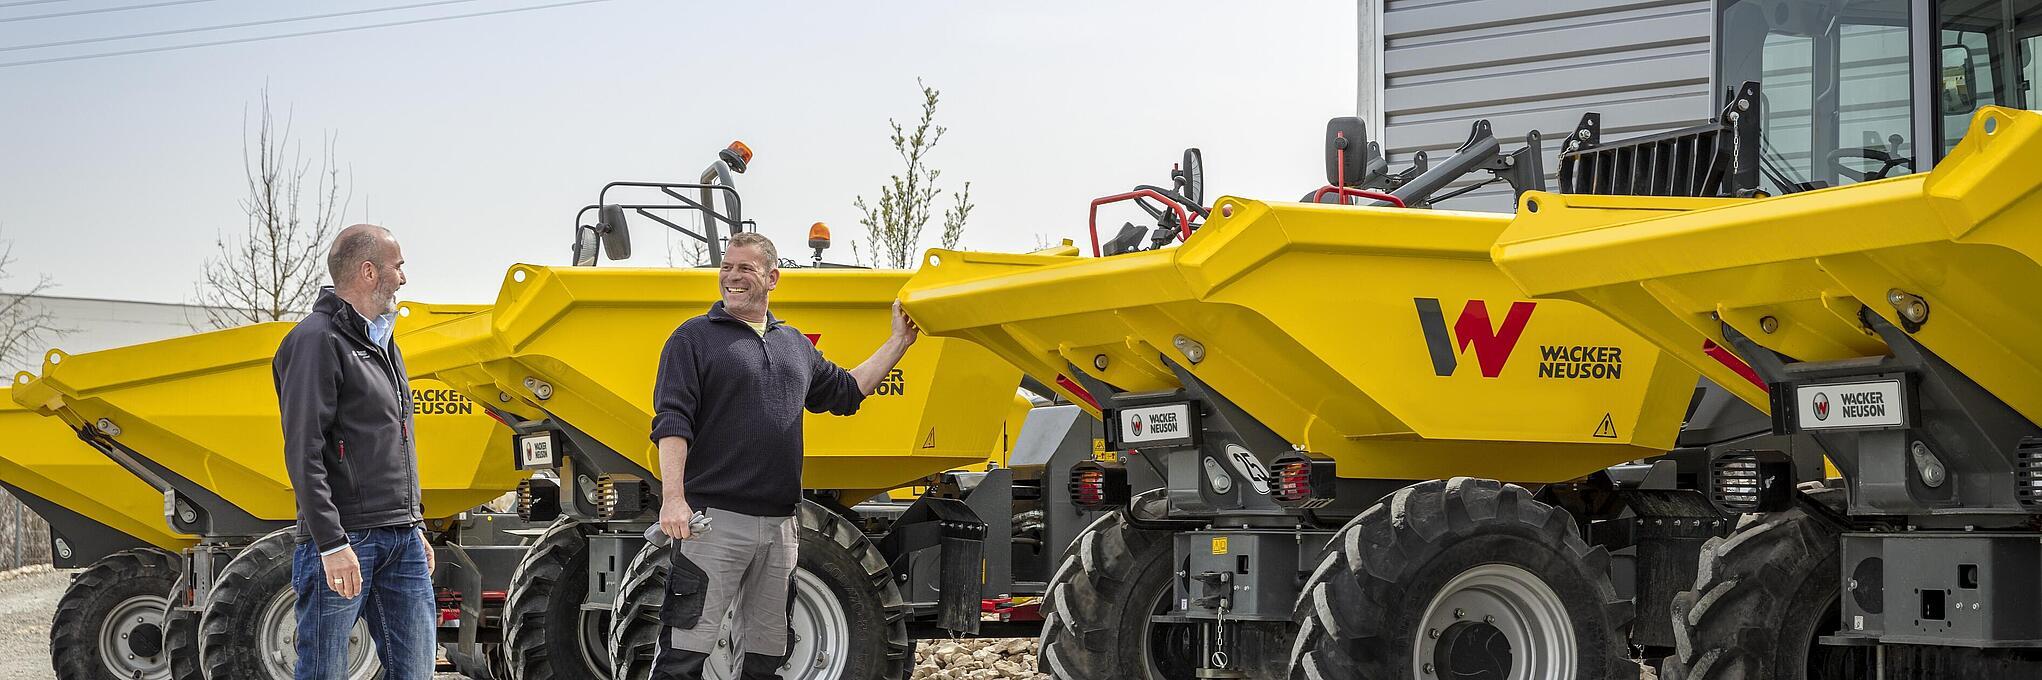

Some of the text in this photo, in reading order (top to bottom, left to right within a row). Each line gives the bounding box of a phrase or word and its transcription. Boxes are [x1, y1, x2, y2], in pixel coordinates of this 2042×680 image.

[1540, 346, 1622, 362] WACKER
[1538, 363, 1621, 379] NEUSON
[1840, 392, 1884, 405] WACKER
[413, 402, 472, 414] EUSON
[1842, 404, 1885, 418] NEUSON
[1149, 412, 1177, 424] WACKER
[1150, 423, 1178, 434] NEUSON
